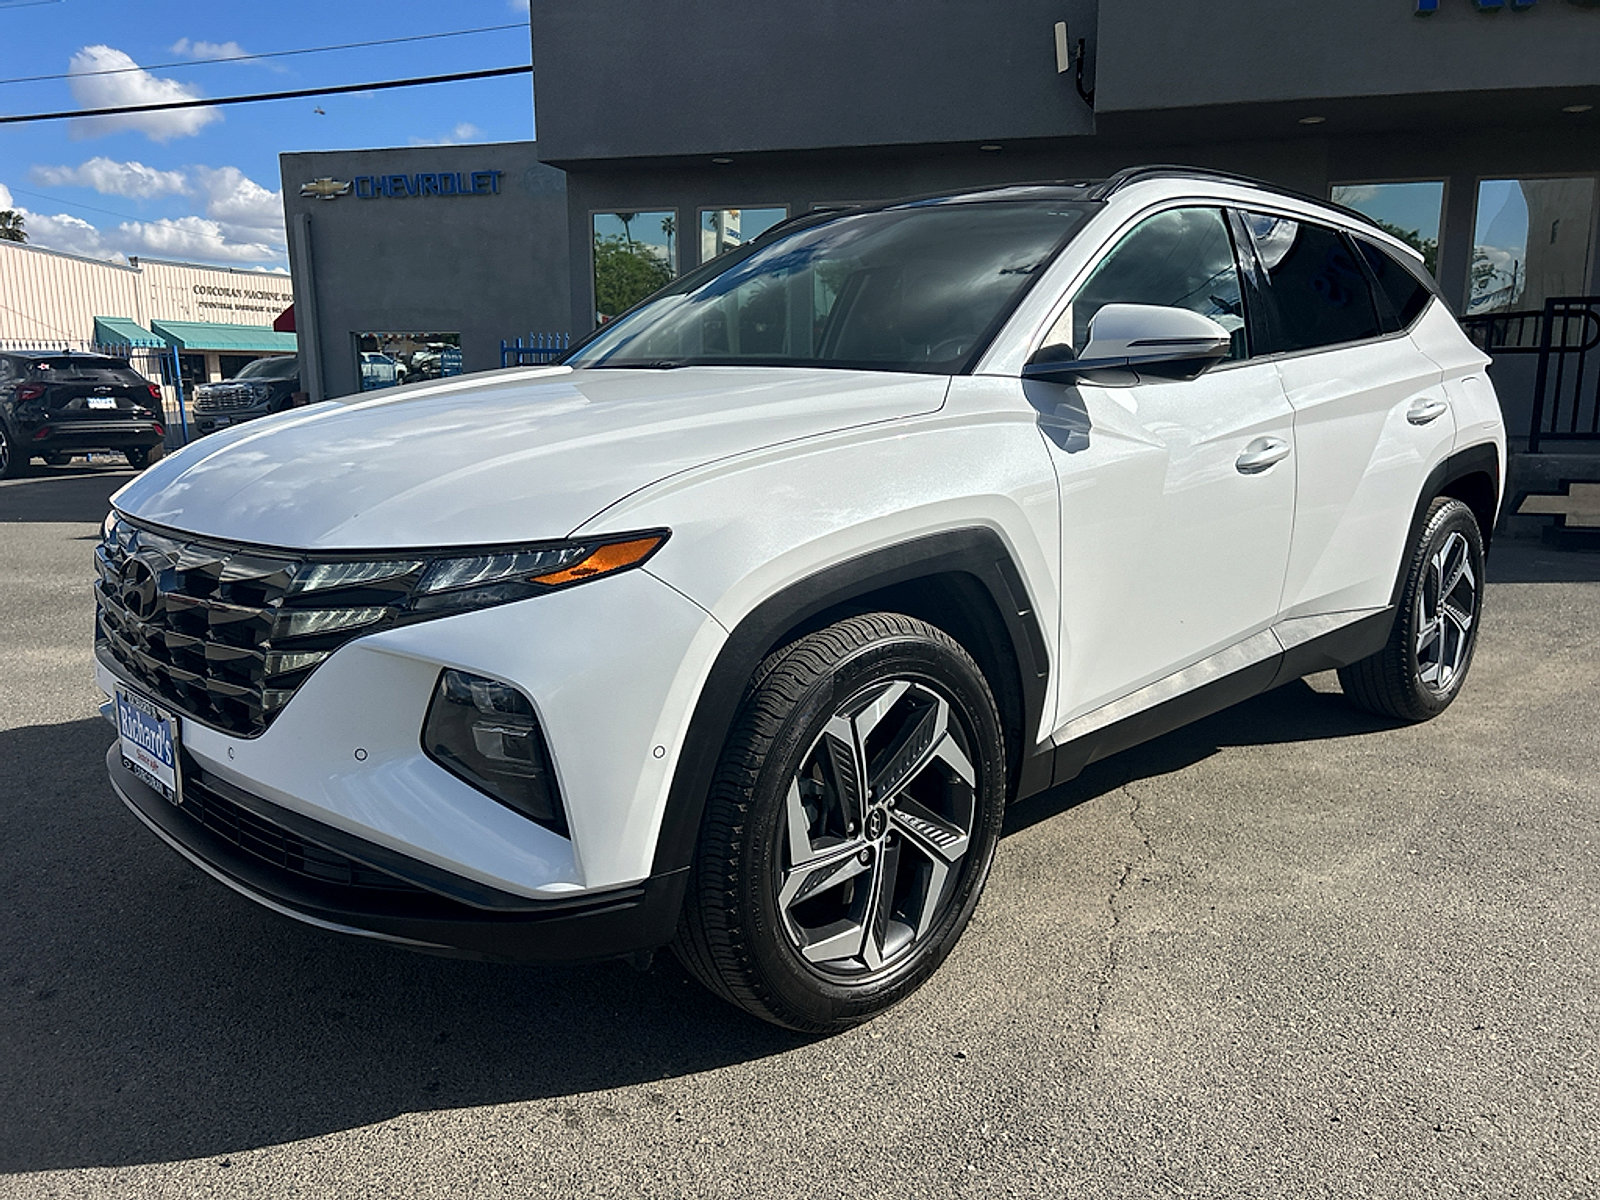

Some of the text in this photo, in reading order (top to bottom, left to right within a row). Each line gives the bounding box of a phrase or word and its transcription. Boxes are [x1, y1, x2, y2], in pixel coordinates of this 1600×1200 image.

[354, 171, 502, 197] CHEVROLET
[193, 285, 242, 298] CORCORAN
[120, 704, 172, 765] Richard's
